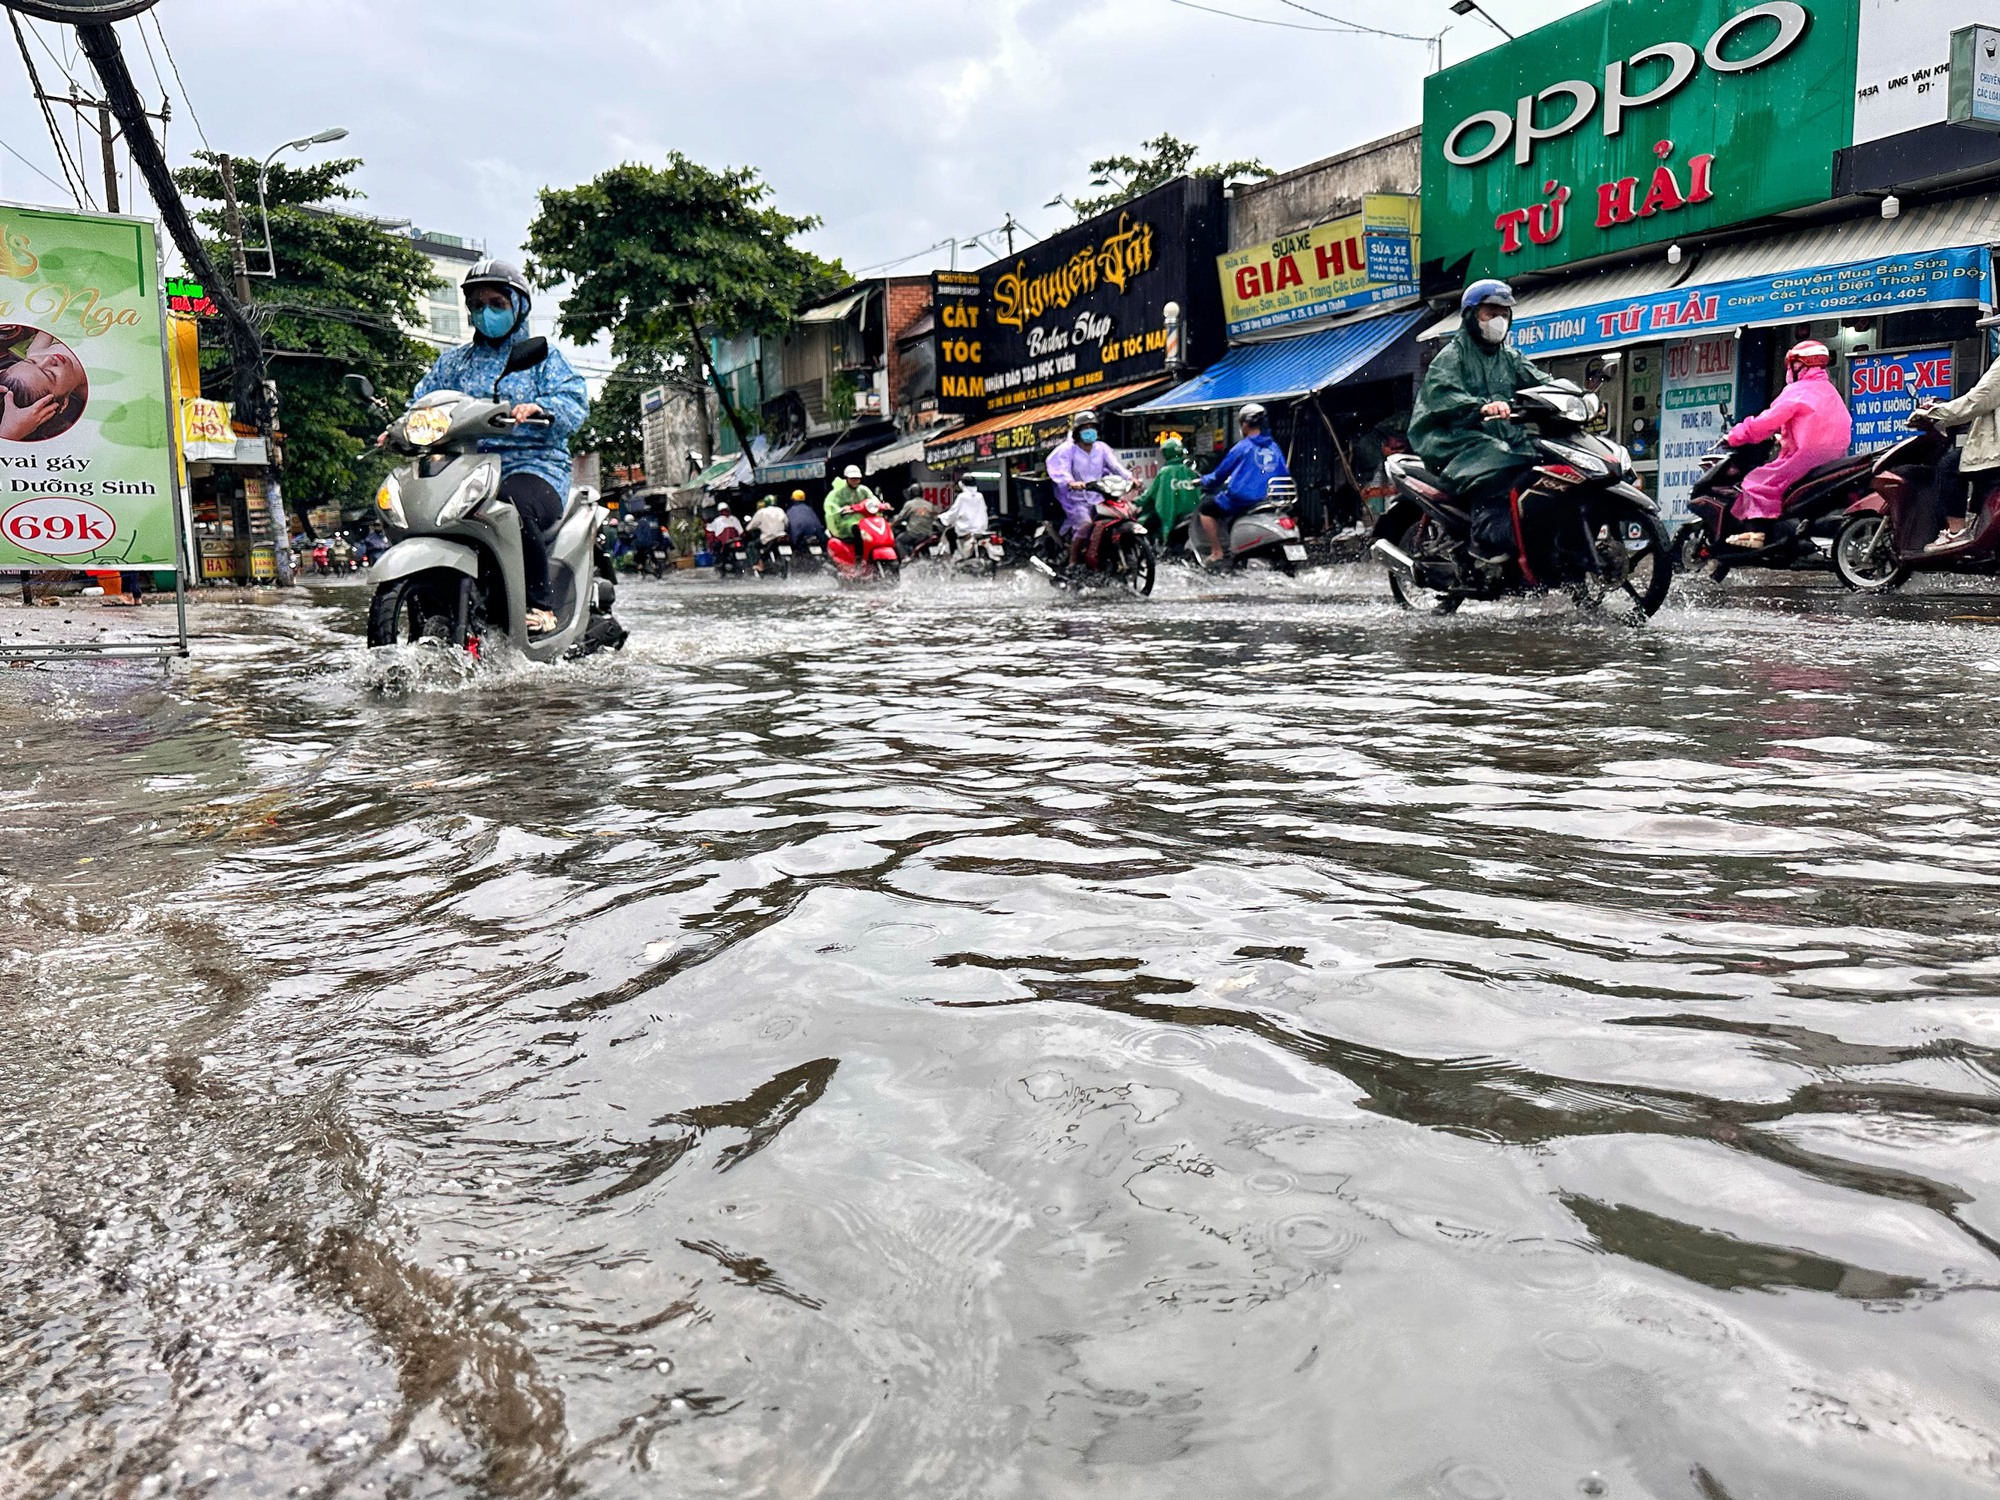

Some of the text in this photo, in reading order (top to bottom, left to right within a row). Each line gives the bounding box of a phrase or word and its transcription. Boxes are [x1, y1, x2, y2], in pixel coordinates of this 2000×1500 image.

[1857, 62, 1950, 98] 143A UNG VĂN KHI
[1495, 139, 1715, 253] TỨ HẢI
[1296, 233, 1311, 251] XE
[1370, 241, 1407, 256] SỬA XE
[1235, 254, 1304, 301] GIA
[1769, 287, 1798, 301] Các
[1801, 283, 1835, 299] Loại
[1838, 278, 1875, 294] Điện
[1878, 273, 1927, 290] Thoại
[1931, 268, 1949, 282] Di
[1772, 273, 1833, 291] Chuyên
[1837, 268, 1871, 281] Mua
[1876, 263, 1908, 277] Bán
[1308, 284, 1333, 299] Trang
[1783, 300, 1806, 313] ĐT
[1818, 287, 1928, 309] 0982.404.405
[25, 284, 142, 337] Nga
[941, 298, 979, 329] CẮT
[1517, 321, 1544, 350] ĐIỆN
[1549, 316, 1587, 344] THOẠI
[1595, 304, 1646, 338] TỨ
[1649, 291, 1720, 330] HẢI
[941, 336, 982, 364] TÓC
[1101, 337, 1120, 364] CẮT
[1122, 333, 1143, 358] TÓC
[941, 375, 986, 397] NAM
[1882, 396, 1912, 413] KHÔNG
[1011, 424, 1036, 448] 30%
[1856, 421, 1875, 435] THAY
[1877, 416, 1892, 433] THẾ
[0, 455, 91, 472] vai gáy
[11, 478, 156, 497] Dưỡng Sinh
[9, 513, 108, 541] 69k
